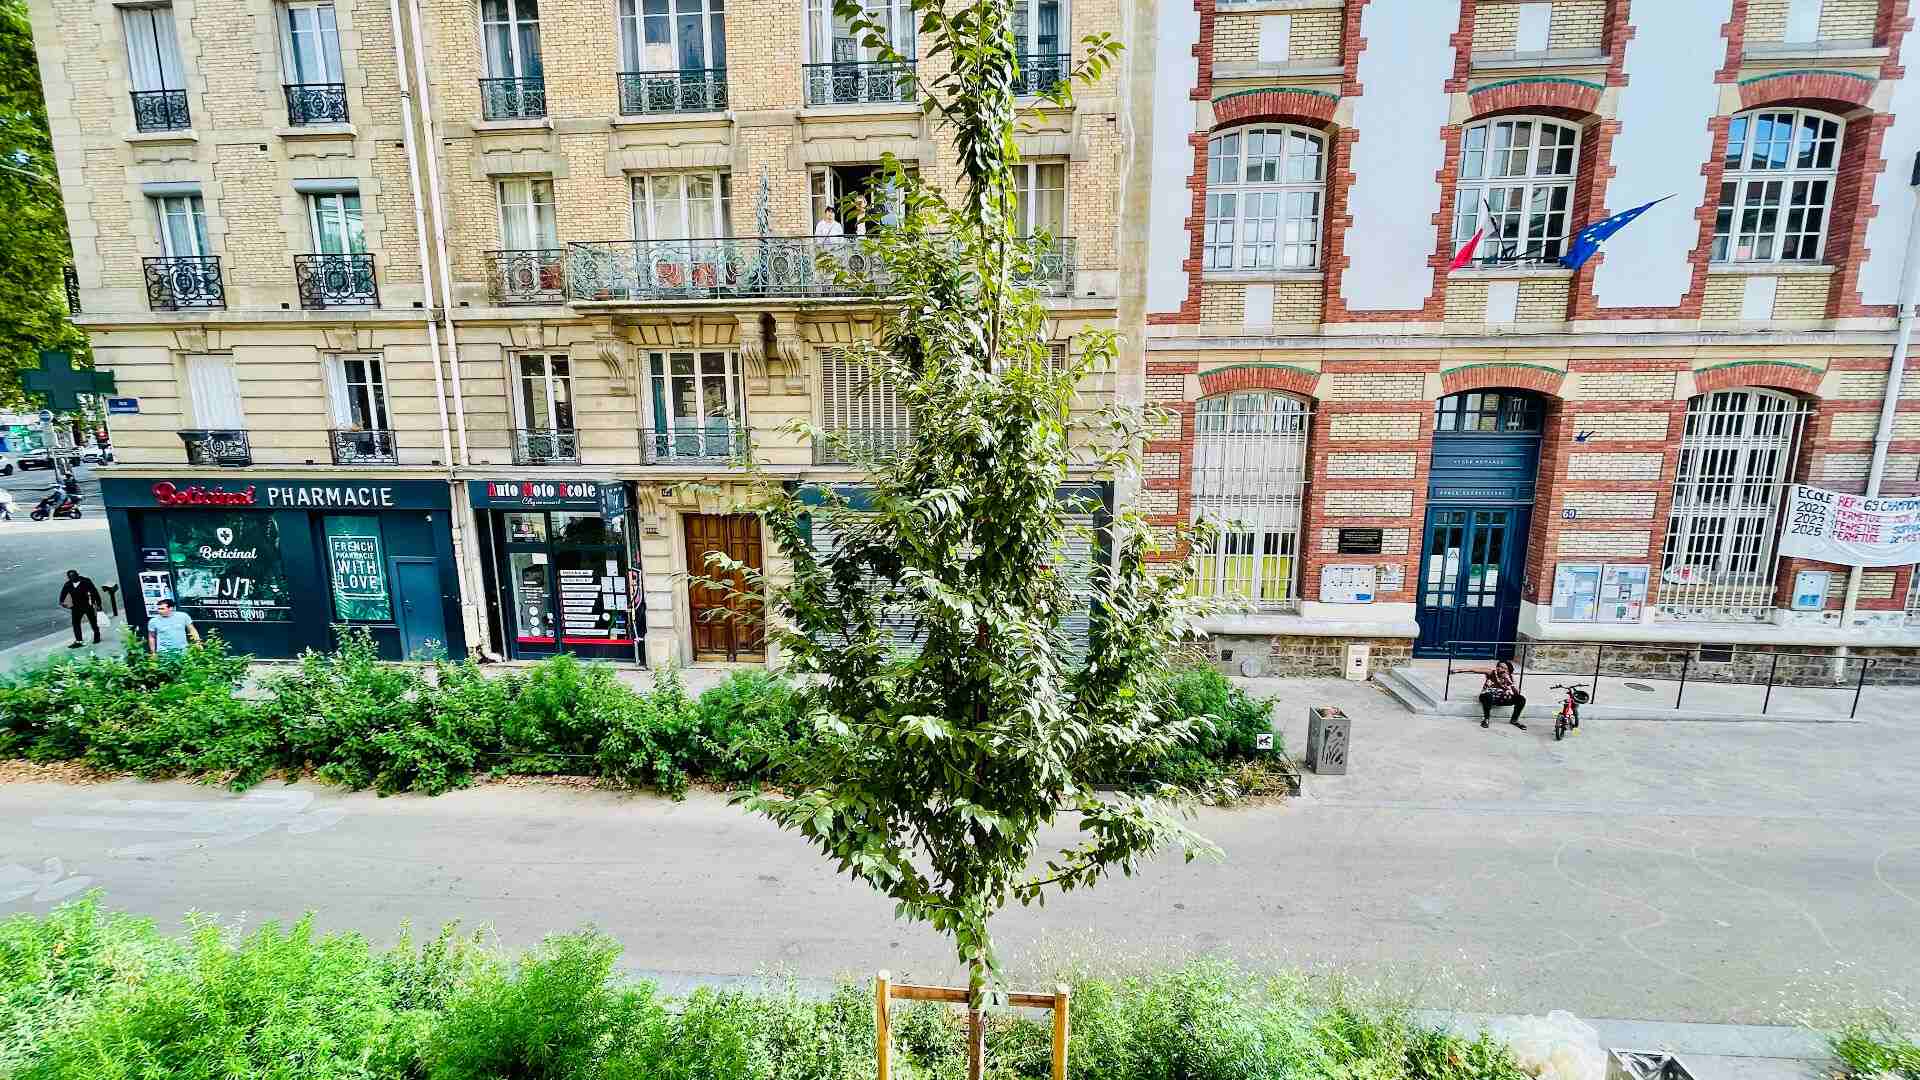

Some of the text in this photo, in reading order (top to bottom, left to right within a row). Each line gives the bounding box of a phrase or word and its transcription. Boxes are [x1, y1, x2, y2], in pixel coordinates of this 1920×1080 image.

[152, 481, 395, 506] Boticinal PHARMACIE
[487, 481, 519, 497] Auto
[522, 481, 555, 497] Moto
[1798, 486, 1834, 504] ECOLE
[1864, 500, 1879, 511] 69
[1796, 501, 1826, 516] 2022
[1791, 523, 1822, 537] 2025
[200, 545, 257, 560] Boticinal
[334, 541, 374, 551] FRENCH
[337, 560, 377, 574] WITH
[341, 574, 378, 589] LOVE
[213, 609, 265, 619] TESTS COVID
